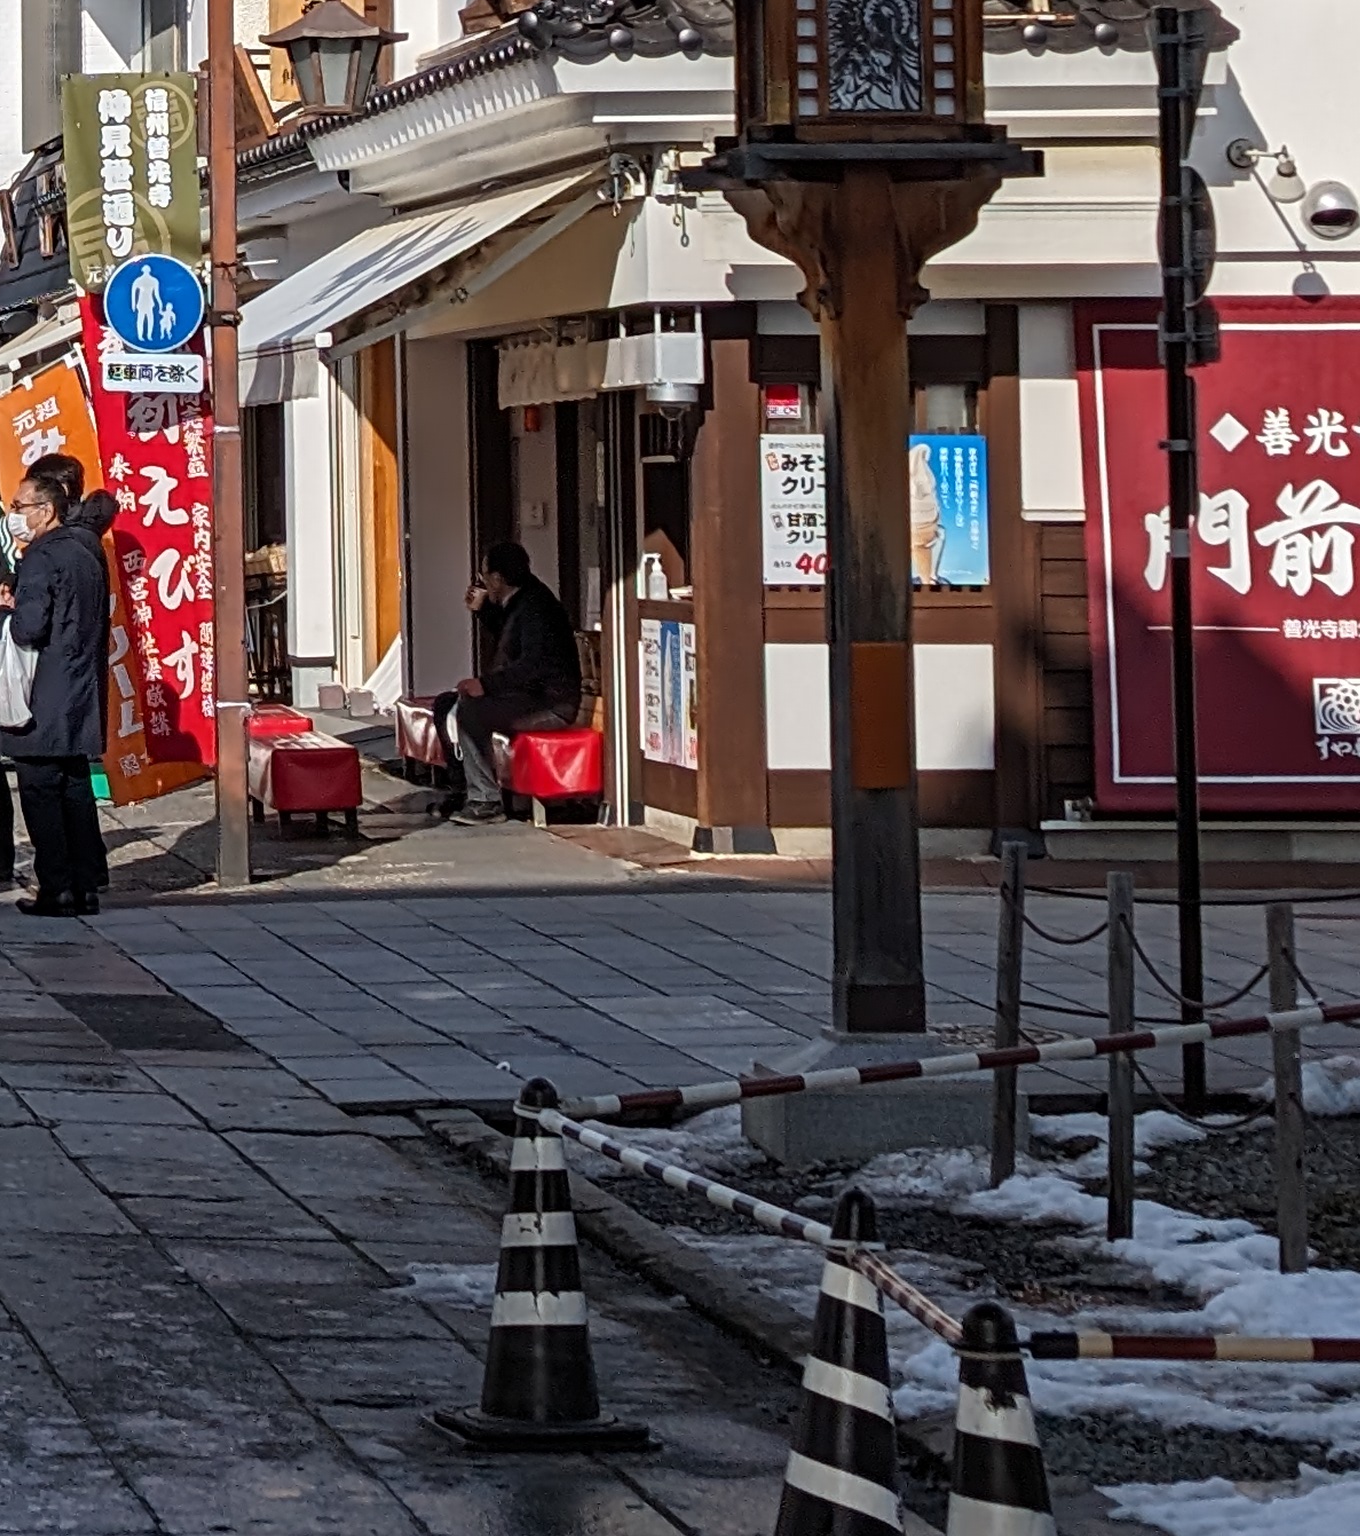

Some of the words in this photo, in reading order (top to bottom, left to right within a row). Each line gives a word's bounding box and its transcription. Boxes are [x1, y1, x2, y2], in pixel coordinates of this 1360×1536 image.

[97, 88, 136, 259] 仲見世通り
[144, 87, 173, 210] 信州善光寺
[12, 394, 61, 438] 元祖
[107, 363, 200, 383] 軽車両を除く
[108, 451, 137, 513] 奉納
[191, 501, 214, 600] 家内安全
[1144, 479, 1360, 597] 門前
